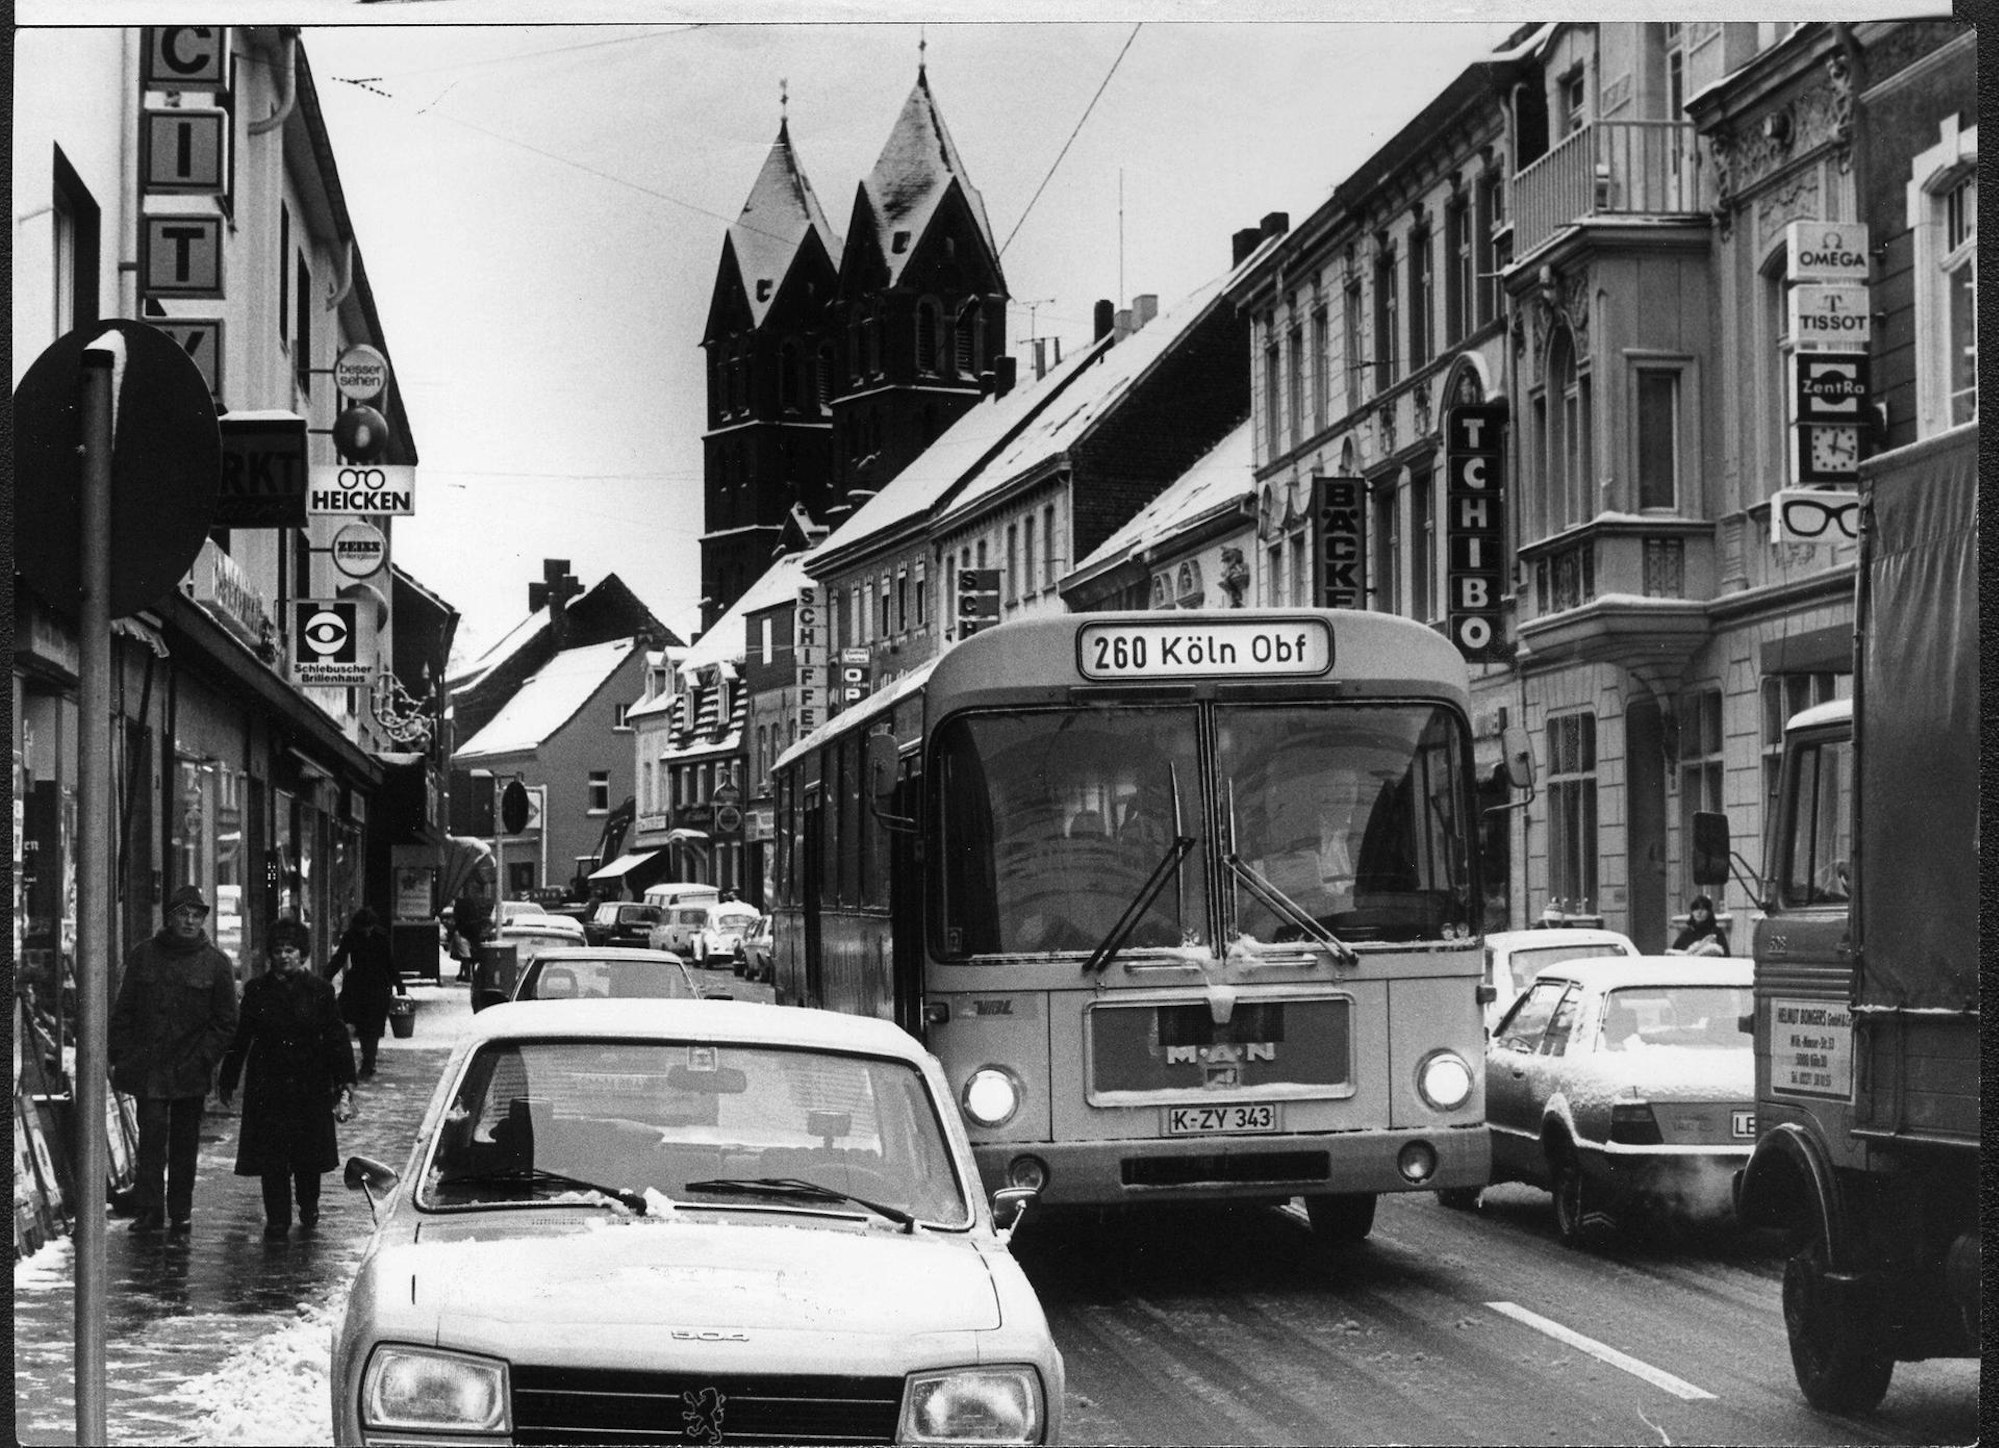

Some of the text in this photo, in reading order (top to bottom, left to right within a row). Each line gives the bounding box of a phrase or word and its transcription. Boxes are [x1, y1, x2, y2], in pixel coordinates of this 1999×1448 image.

[1800, 251, 1866, 267] OMEGA
[1800, 315, 1867, 331] TISSOT
[339, 363, 381, 375] besser
[340, 374, 380, 387] sehen
[1802, 379, 1865, 395] ZentRa
[312, 490, 411, 511] HEICKEN
[1461, 418, 1491, 649] TCHIBO
[338, 541, 381, 553] ZEISS
[1094, 633, 1307, 669] 260 Köln Obf
[294, 663, 373, 674] Schlebuscher
[301, 674, 366, 683] Brillenhaus
[1173, 1107, 1272, 1131] K-ZY 343
